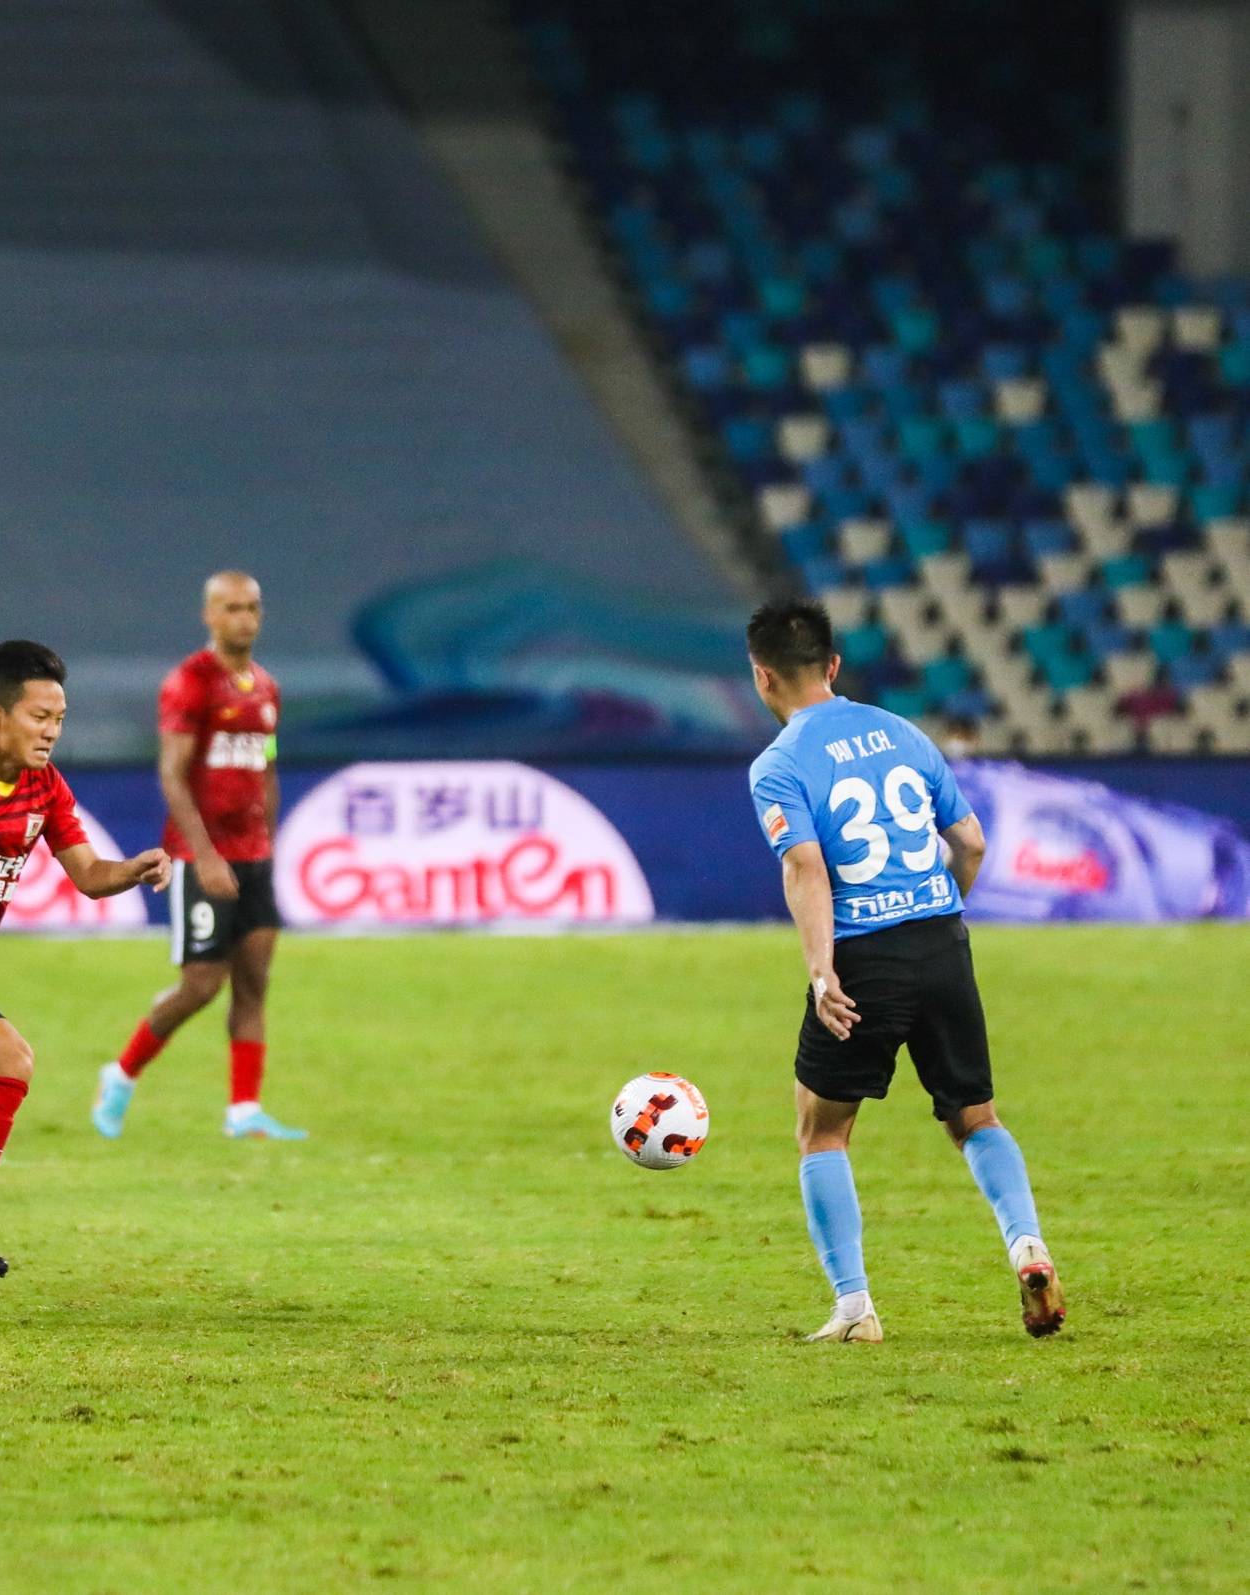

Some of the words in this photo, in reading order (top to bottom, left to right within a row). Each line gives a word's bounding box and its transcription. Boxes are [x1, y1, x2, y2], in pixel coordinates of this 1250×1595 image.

[825, 739, 855, 764] YAN
[345, 780, 544, 836] 百岁山
[829, 764, 938, 885] 39
[190, 901, 215, 940] 9
